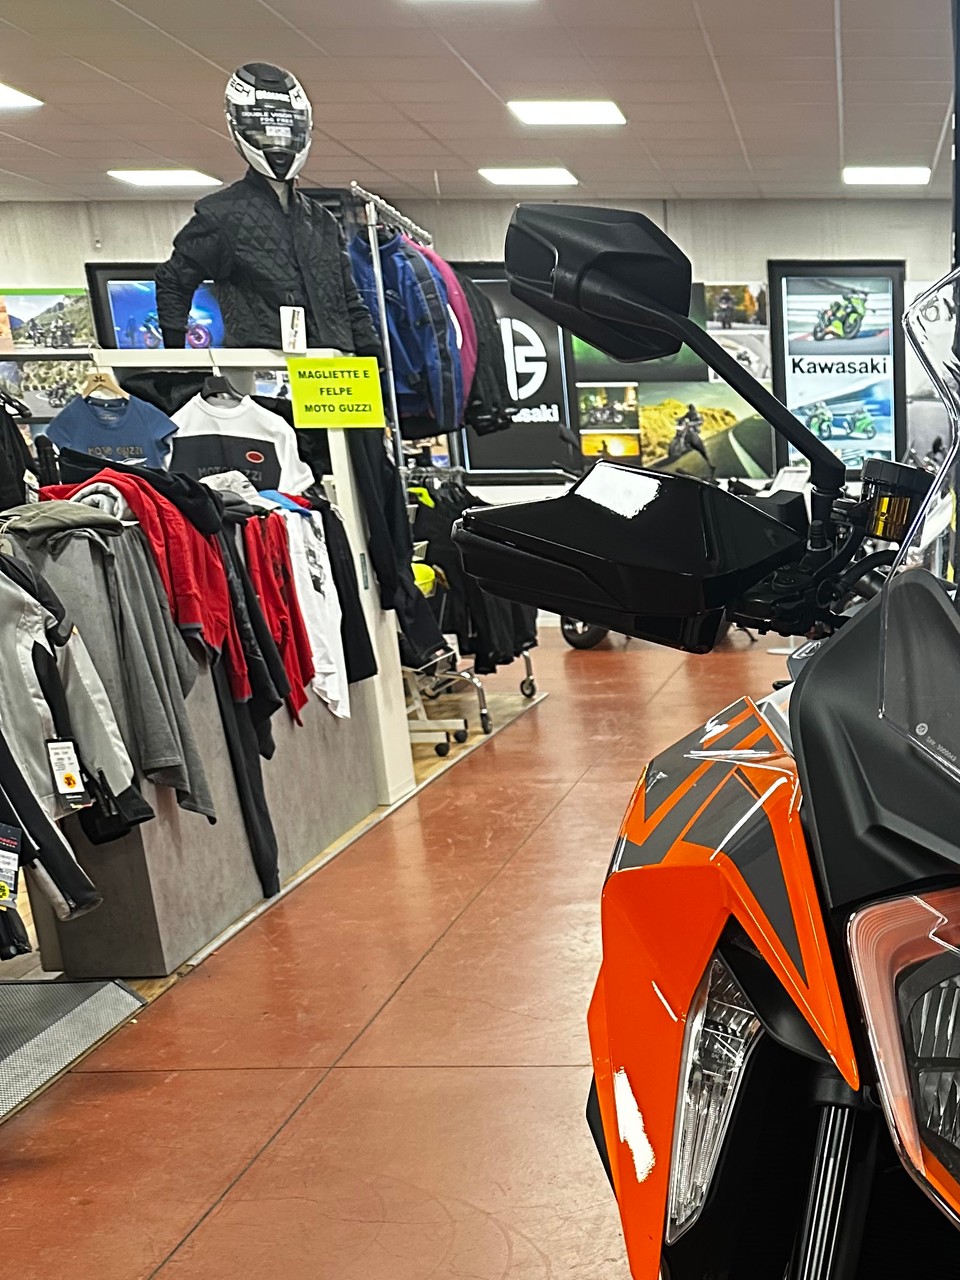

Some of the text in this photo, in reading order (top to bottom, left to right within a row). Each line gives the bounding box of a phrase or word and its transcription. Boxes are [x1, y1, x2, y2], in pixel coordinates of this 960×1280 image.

[792, 357, 887, 374] Kawasaki
[298, 370, 370, 379] MAGLIETTE E
[319, 387, 353, 396] FELPE
[304, 403, 372, 413] MOTO GUZZI
